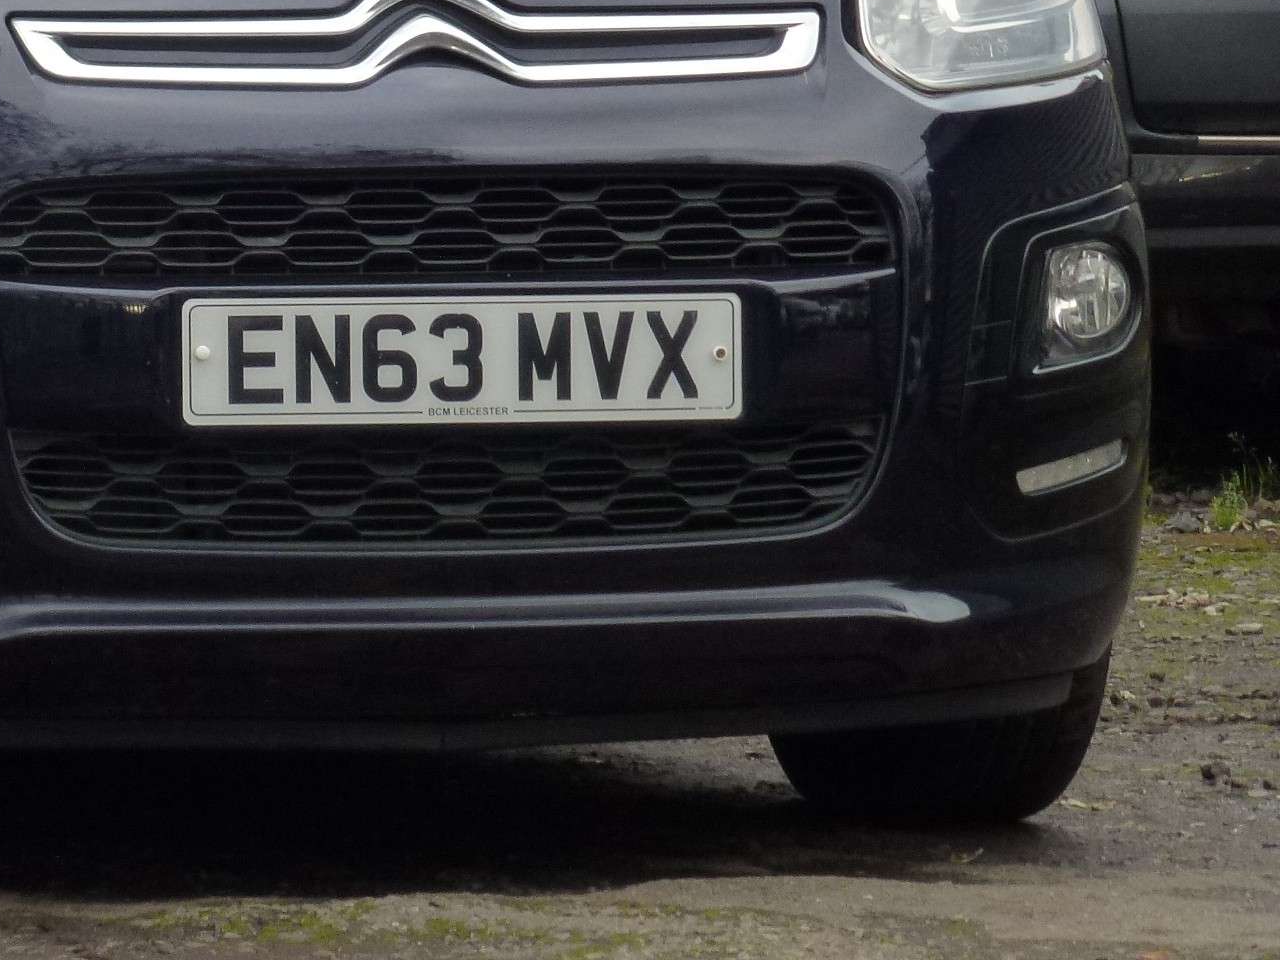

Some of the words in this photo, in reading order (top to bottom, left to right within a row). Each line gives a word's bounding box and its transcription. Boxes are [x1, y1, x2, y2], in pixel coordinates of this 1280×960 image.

[228, 313, 483, 405] EN63
[518, 310, 698, 401] MVX
[428, 407, 451, 417] BCM
[453, 406, 509, 416] LEICESTER
